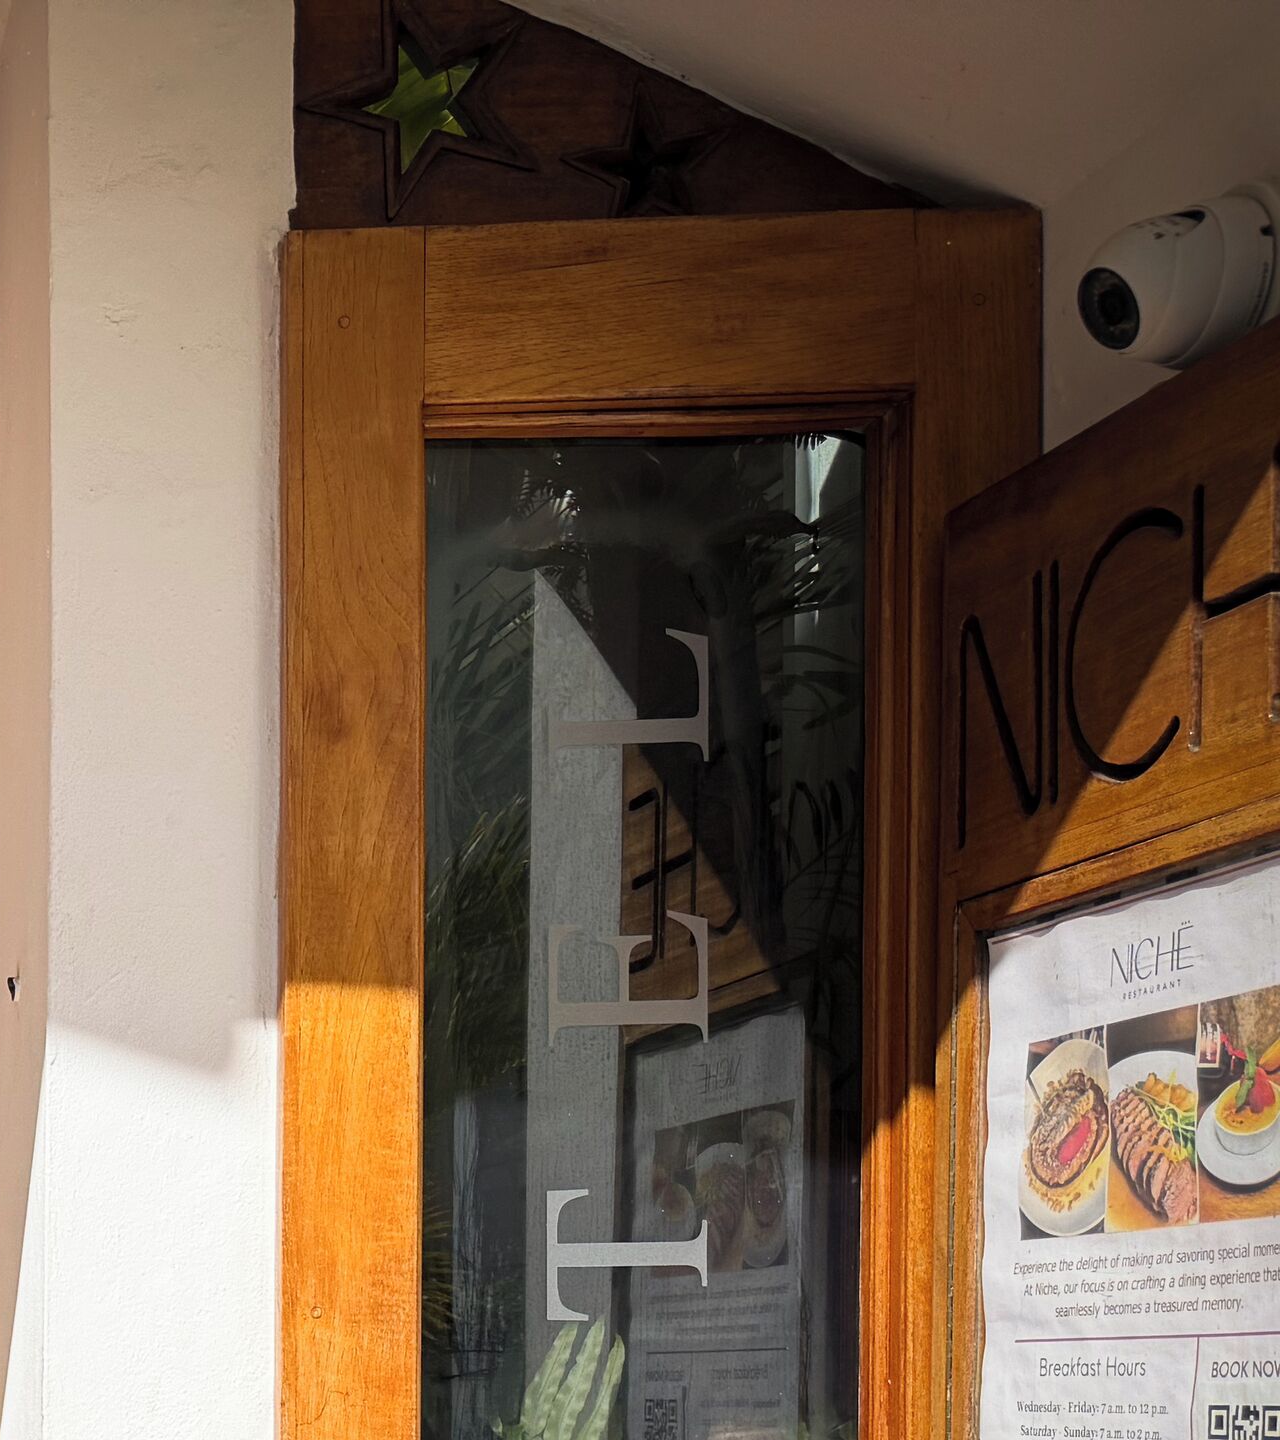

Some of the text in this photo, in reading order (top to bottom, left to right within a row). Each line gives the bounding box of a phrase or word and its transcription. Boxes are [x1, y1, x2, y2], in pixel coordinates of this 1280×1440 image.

[1123, 979, 1181, 1000] RESTAURANT
[1013, 1262, 1056, 1277] Experience
[1059, 1258, 1073, 1271] the
[1076, 1256, 1108, 1272] delight
[1110, 1254, 1120, 1268] of
[1121, 1253, 1154, 1268] making
[1155, 1251, 1174, 1264] and
[1176, 1249, 1214, 1264] savoring
[1217, 1245, 1250, 1263] special
[1024, 1284, 1032, 1296] At
[1035, 1282, 1060, 1296] Niche,
[1063, 1283, 1078, 1294] our
[1080, 1279, 1105, 1293] focus
[1106, 1279, 1115, 1291] is
[1131, 1275, 1166, 1290] crafting
[1168, 1276, 1175, 1288] a
[1178, 1272, 1206, 1287] dining
[1209, 1268, 1261, 1286] experience
[1263, 1267, 1280, 1282] that
[1055, 1303, 1100, 1320] seamlessly
[1103, 1302, 1142, 1315] becomes
[1153, 1299, 1199, 1313] treasured
[1201, 1297, 1244, 1314] memory.
[1039, 1357, 1146, 1376] Breakfast Hours
[1211, 1360, 1249, 1378] BOOK
[1016, 1400, 1062, 1416] Wednesday
[1068, 1401, 1099, 1416] Friday:
[1107, 1404, 1125, 1414] a.m.
[1151, 1403, 1168, 1417] p.m.
[1020, 1424, 1057, 1440] Saturday
[1063, 1425, 1098, 1440] Sunday:
[1106, 1430, 1124, 1439] a.m.
[1136, 1428, 1142, 1440] 2
